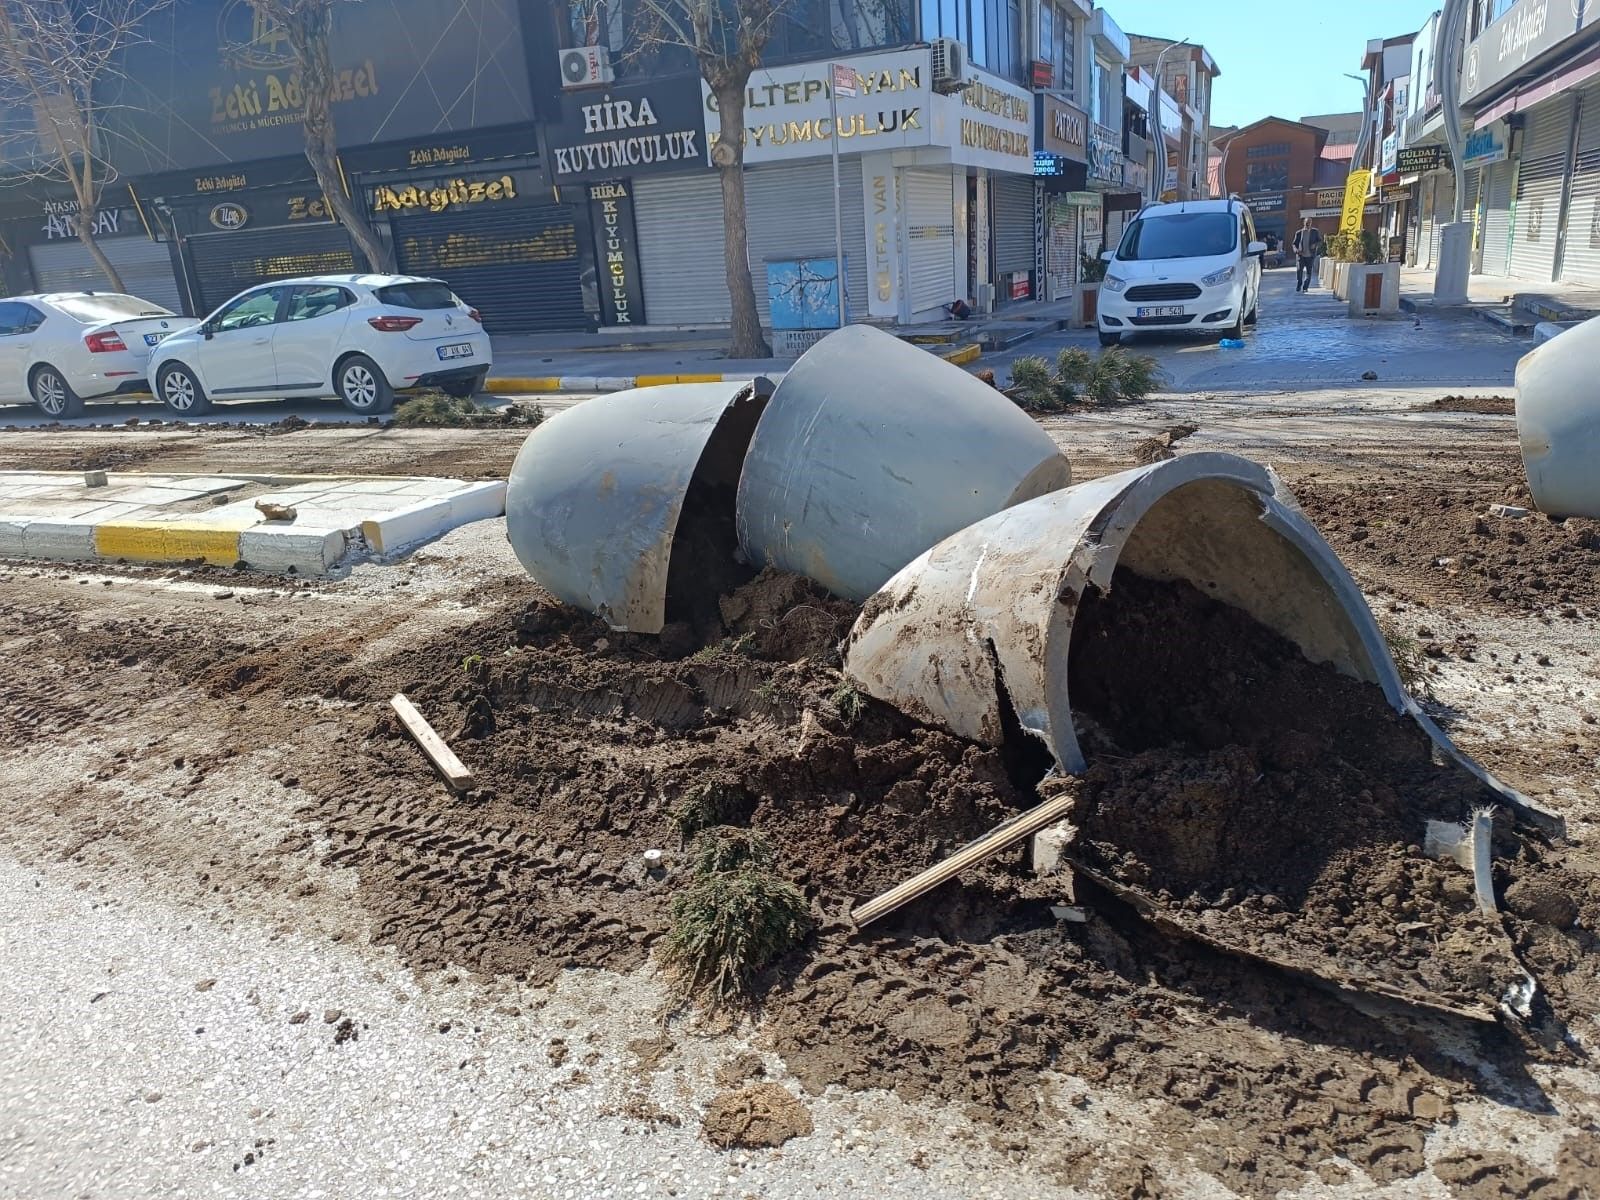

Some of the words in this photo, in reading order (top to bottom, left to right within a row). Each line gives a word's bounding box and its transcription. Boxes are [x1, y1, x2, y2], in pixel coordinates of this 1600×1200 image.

[209, 80, 262, 123] Zeki
[266, 60, 378, 111] Adzel
[706, 79, 832, 112] GLTEP
[856, 66, 920, 95] VAN
[581, 94, 658, 134] HİRA
[708, 107, 921, 149] KYUMCULUK
[554, 130, 699, 174] KUYUMCULUK
[590, 180, 627, 199] HİRA
[45, 209, 118, 239] ATSAY
[602, 201, 630, 323] KUYUMCULUK
